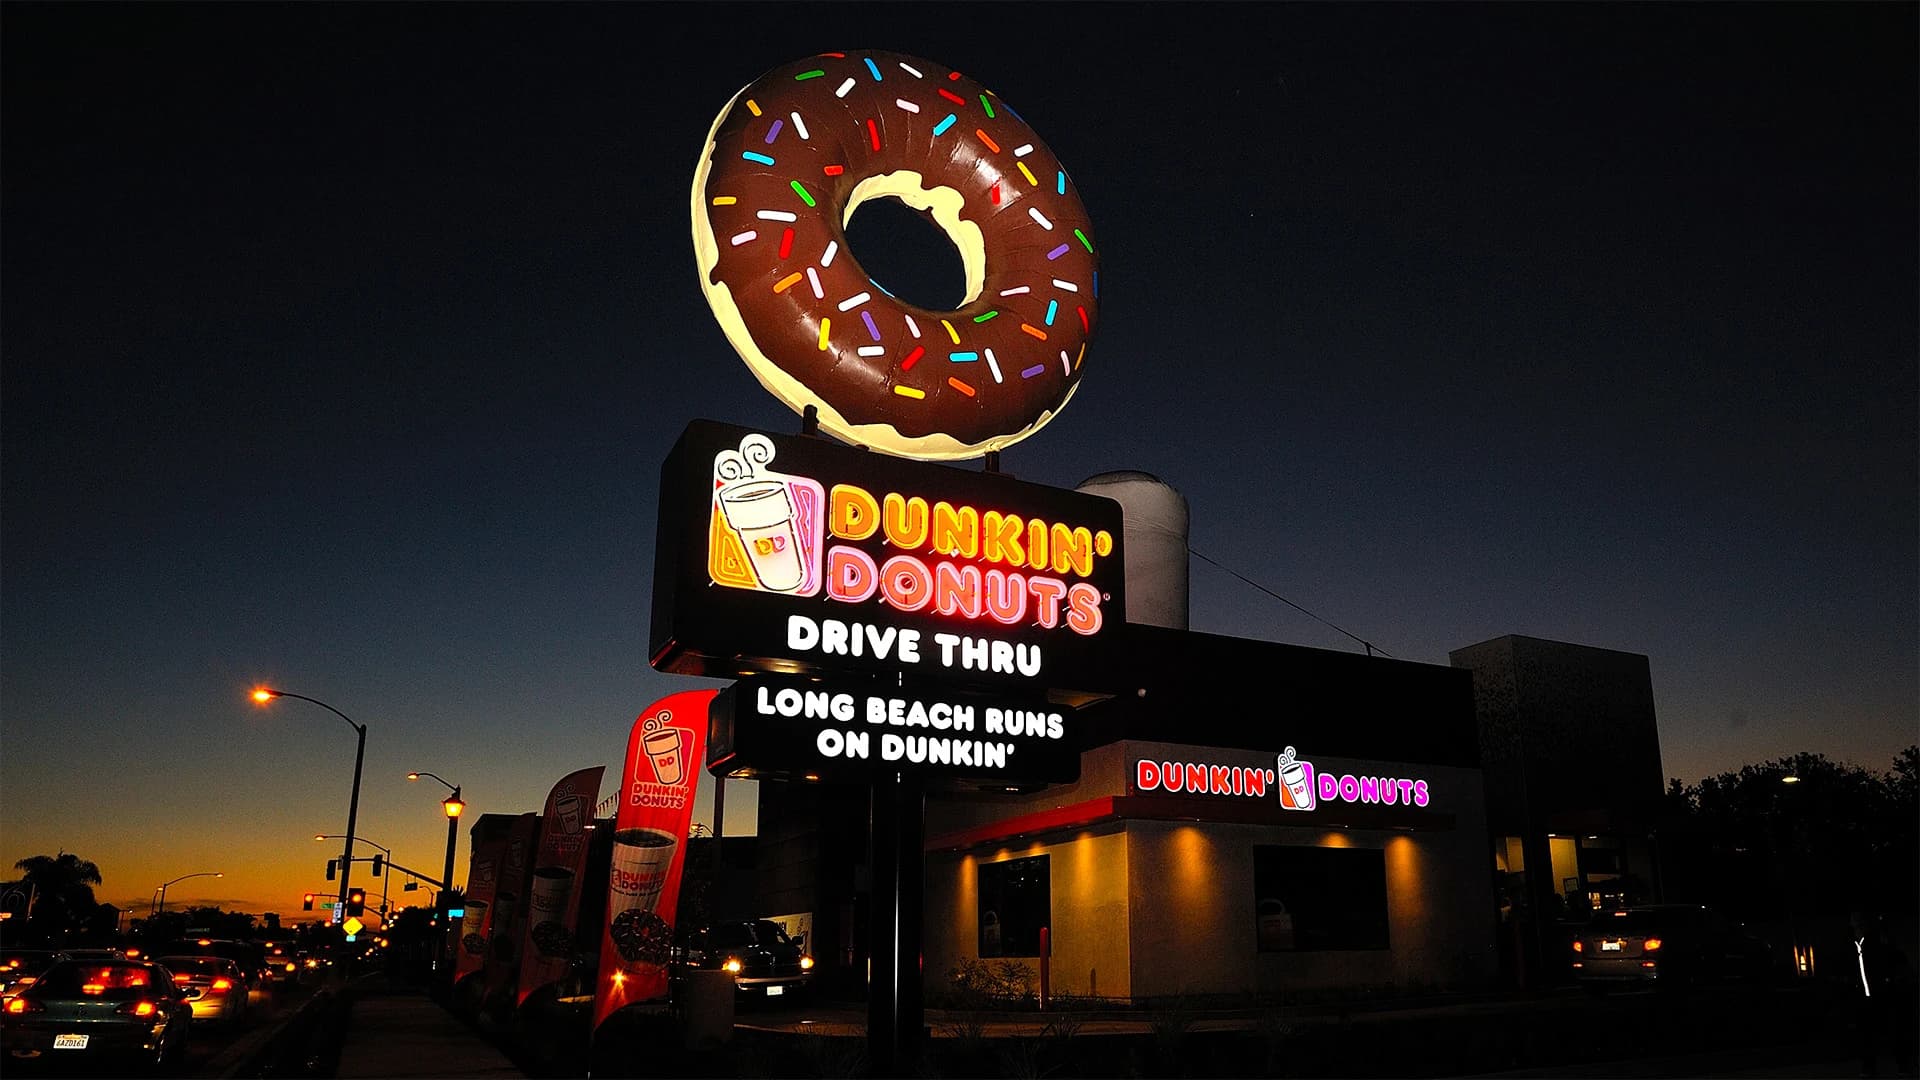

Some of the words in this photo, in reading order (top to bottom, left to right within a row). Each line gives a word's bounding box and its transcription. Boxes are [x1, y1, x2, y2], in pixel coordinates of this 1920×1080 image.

[753, 536, 785, 556] DD
[829, 484, 1113, 578] DUNKIN'
[827, 545, 1103, 635] DONUTS
[787, 615, 921, 663] DRIVE
[934, 633, 1042, 677] THRU
[757, 686, 855, 722] LONG
[867, 697, 975, 733] BEACH
[986, 708, 1064, 739] RUNS
[658, 756, 674, 767] DD
[817, 729, 869, 759] ON
[882, 734, 1015, 768] DUNKIN'
[632, 783, 689, 798] DUNKIN'
[1137, 760, 1273, 797] DUNKIN'
[1318, 773, 1429, 807] DONUTS
[631, 795, 685, 808] DONUTS
